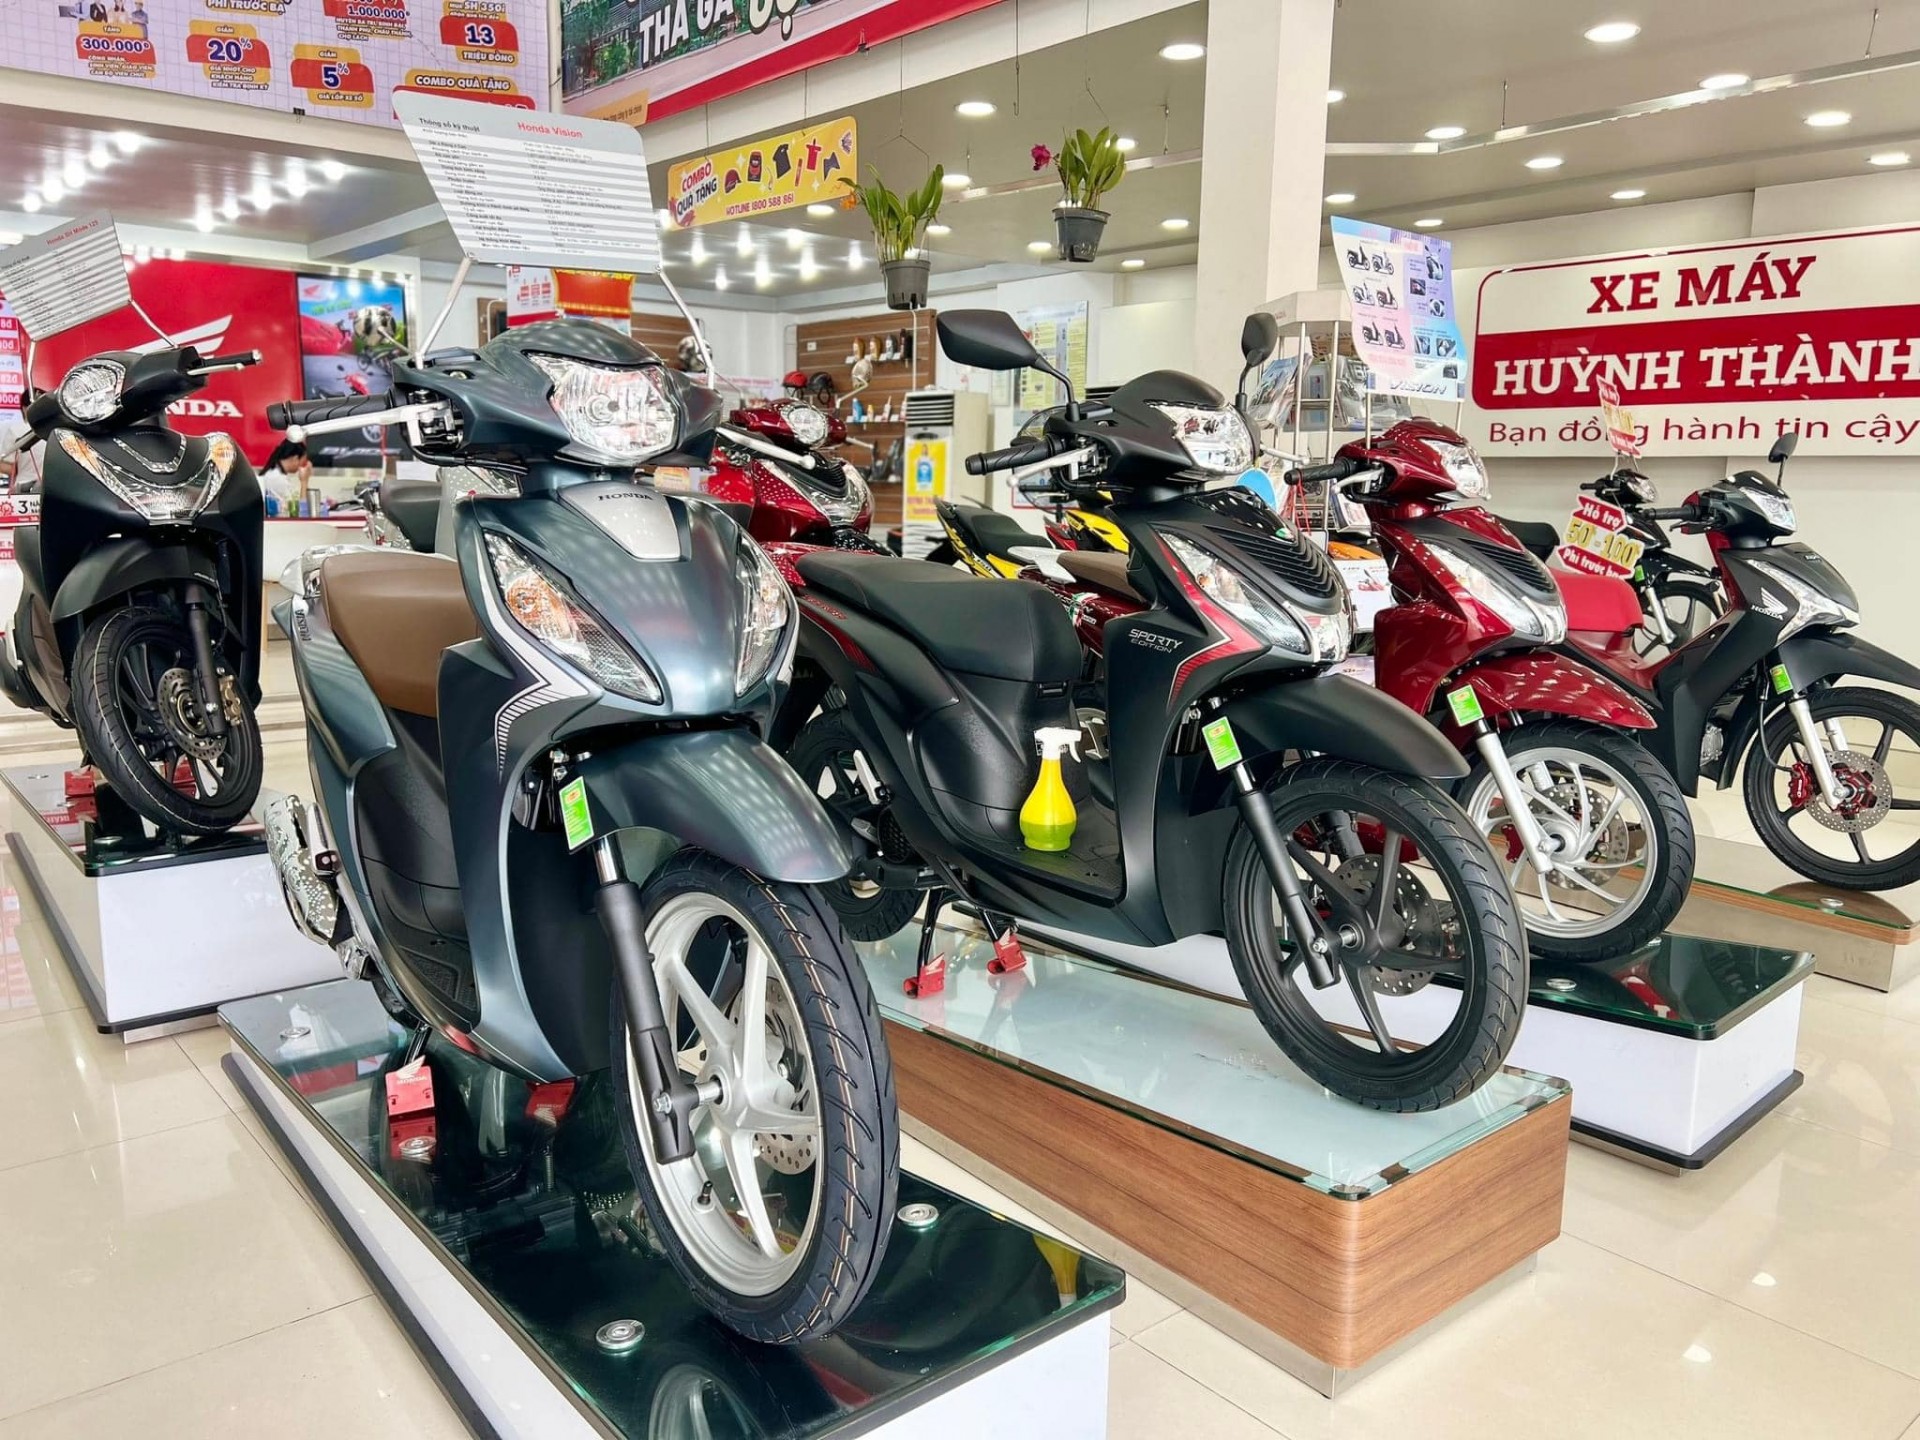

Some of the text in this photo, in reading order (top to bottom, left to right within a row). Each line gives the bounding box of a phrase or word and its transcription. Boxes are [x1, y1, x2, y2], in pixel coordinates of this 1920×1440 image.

[268, 2, 286, 15] BẠ
[464, 1, 478, 10] SH
[466, 24, 495, 45] 13
[207, 38, 252, 62] 20%
[462, 50, 488, 63] TRIỆU
[322, 62, 350, 88] 5%
[415, 75, 511, 93] COMBO QUÀ TẶNG
[517, 122, 583, 139] Honda Vision
[681, 162, 713, 193] COMBO
[677, 177, 718, 215] QUÀ TẶNG
[726, 202, 751, 216] HOTLINE
[46, 234, 65, 245] Honda
[1587, 252, 1817, 313] XE MÁY
[1492, 333, 1920, 396] HUỲNH THÀNH
[165, 398, 244, 418] NDA
[1489, 421, 1547, 446] Bạn
[1558, 416, 1649, 446] đồg
[1663, 416, 1760, 441] hành
[1775, 418, 1829, 439] tin
[1845, 413, 1920, 444] cậy
[598, 492, 653, 501] HONDA
[18, 500, 28, 514] 3
[1751, 604, 1784, 620] HONDA
[1128, 628, 1183, 649] SPORTY
[1131, 639, 1172, 653] EDITION
